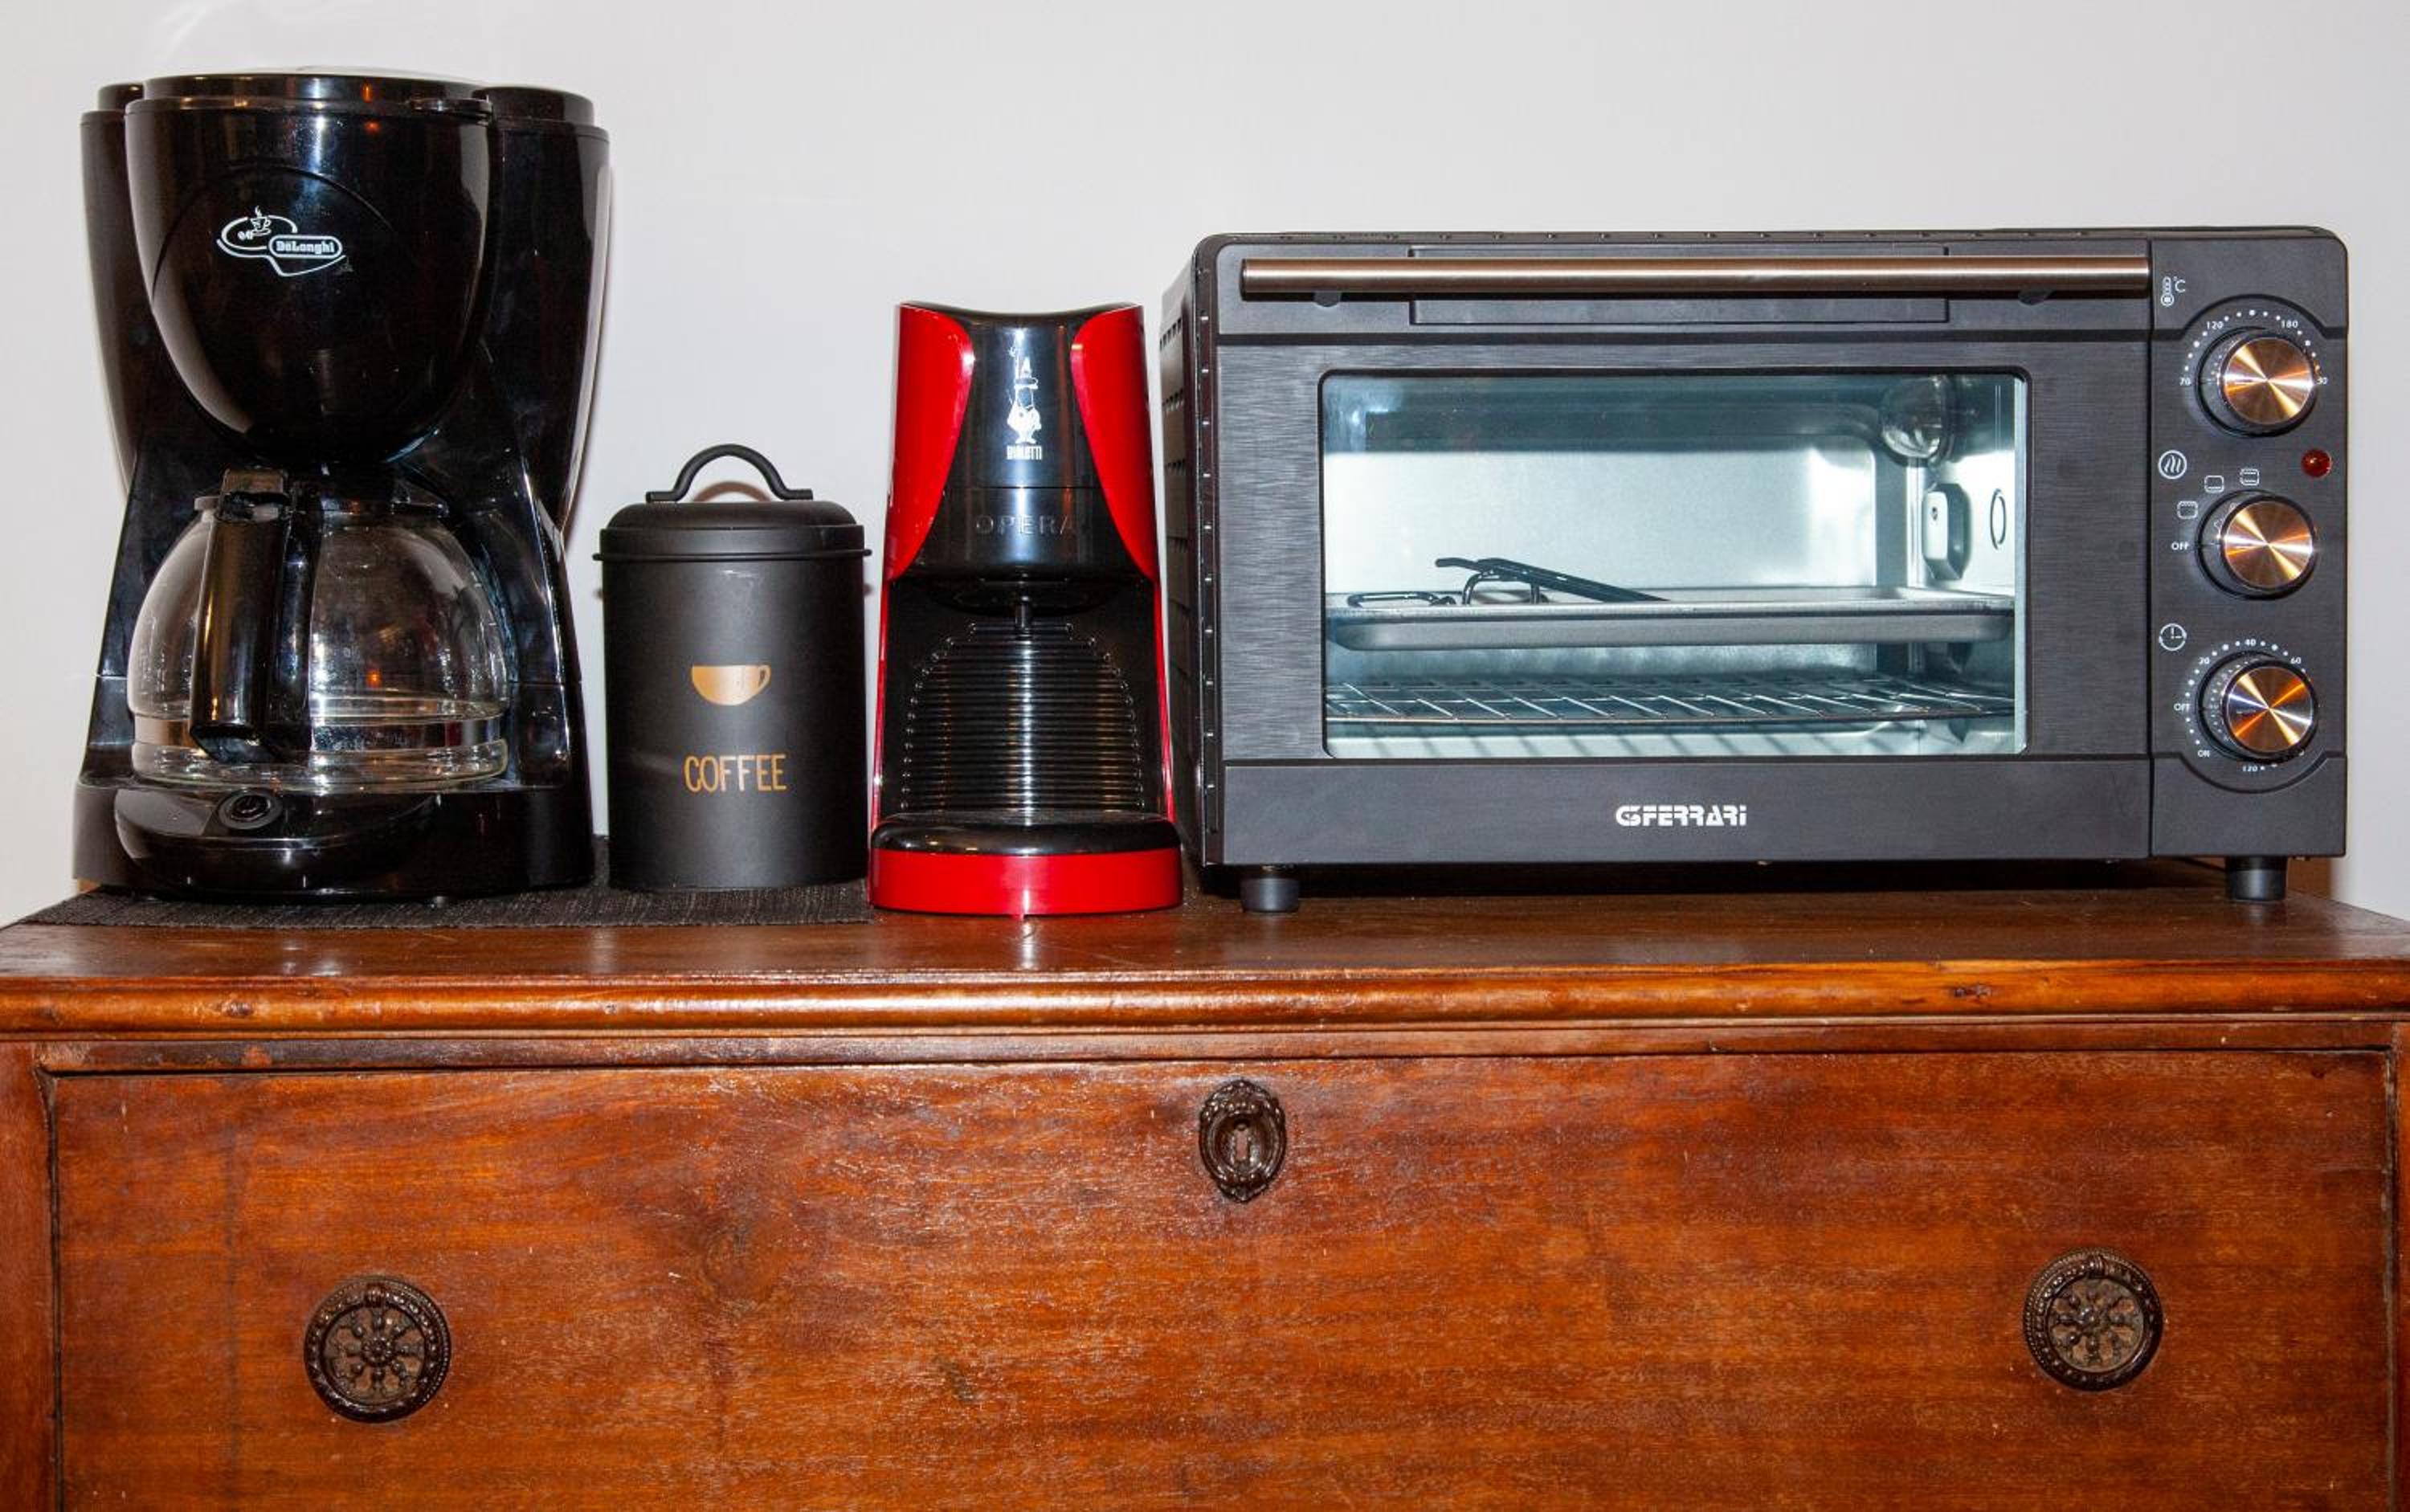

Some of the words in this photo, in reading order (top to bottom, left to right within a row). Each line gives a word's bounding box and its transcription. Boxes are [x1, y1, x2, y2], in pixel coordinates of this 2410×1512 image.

[2207, 321, 2224, 329] 120
[2281, 321, 2298, 329] 180
[2179, 377, 2191, 386] 70
[976, 515, 1075, 535] OPERA
[2245, 638, 2257, 647] 40
[2290, 656, 2302, 664] 60
[2197, 750, 2210, 758] ON
[684, 754, 787, 792] COFFEE
